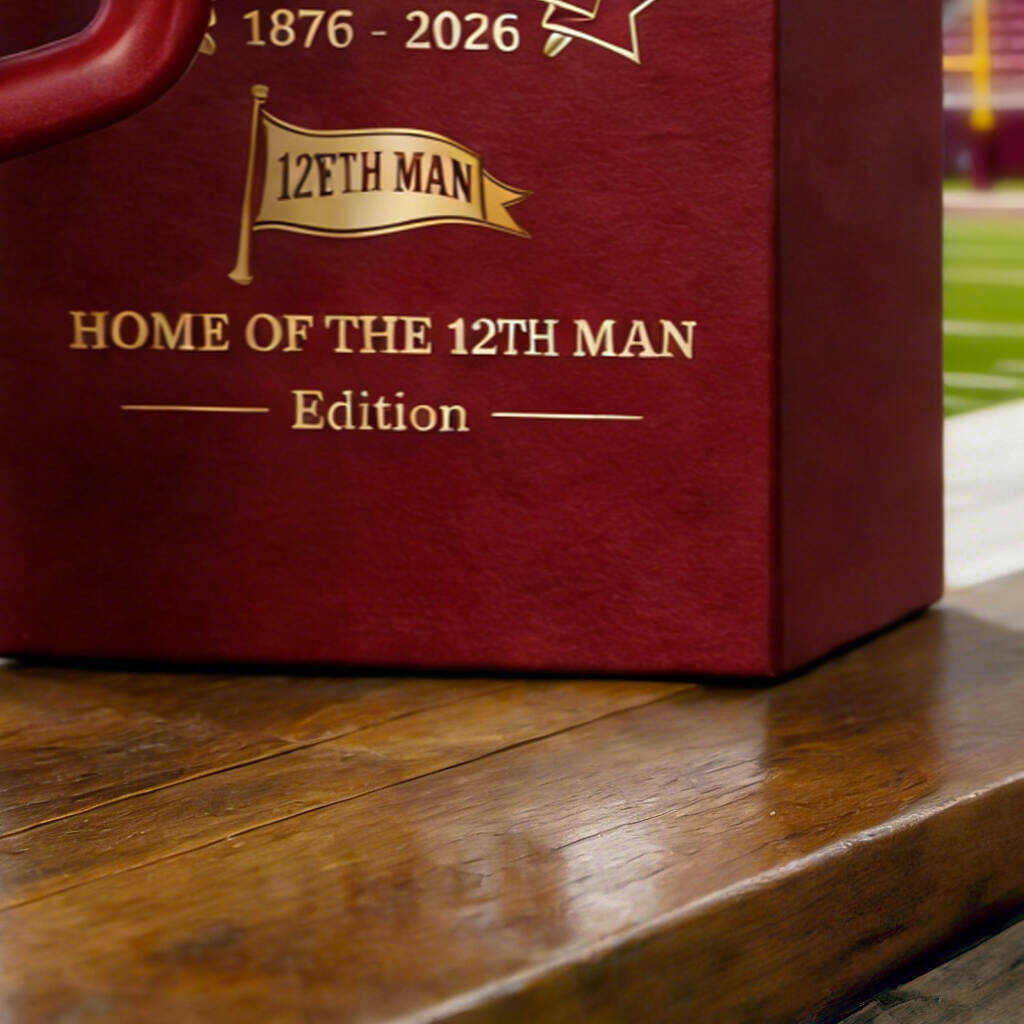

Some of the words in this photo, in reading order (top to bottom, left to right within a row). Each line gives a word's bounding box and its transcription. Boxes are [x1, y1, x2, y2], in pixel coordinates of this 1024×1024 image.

[243, 9, 354, 49] 1876
[404, 10, 521, 52] 2026
[393, 151, 472, 203] MAN
[69, 309, 229, 352] HOME
[245, 313, 314, 353] OF
[324, 314, 432, 356] THE
[447, 317, 559, 358] 12TH
[573, 319, 697, 360] MAN
[291, 389, 470, 432] Edition
